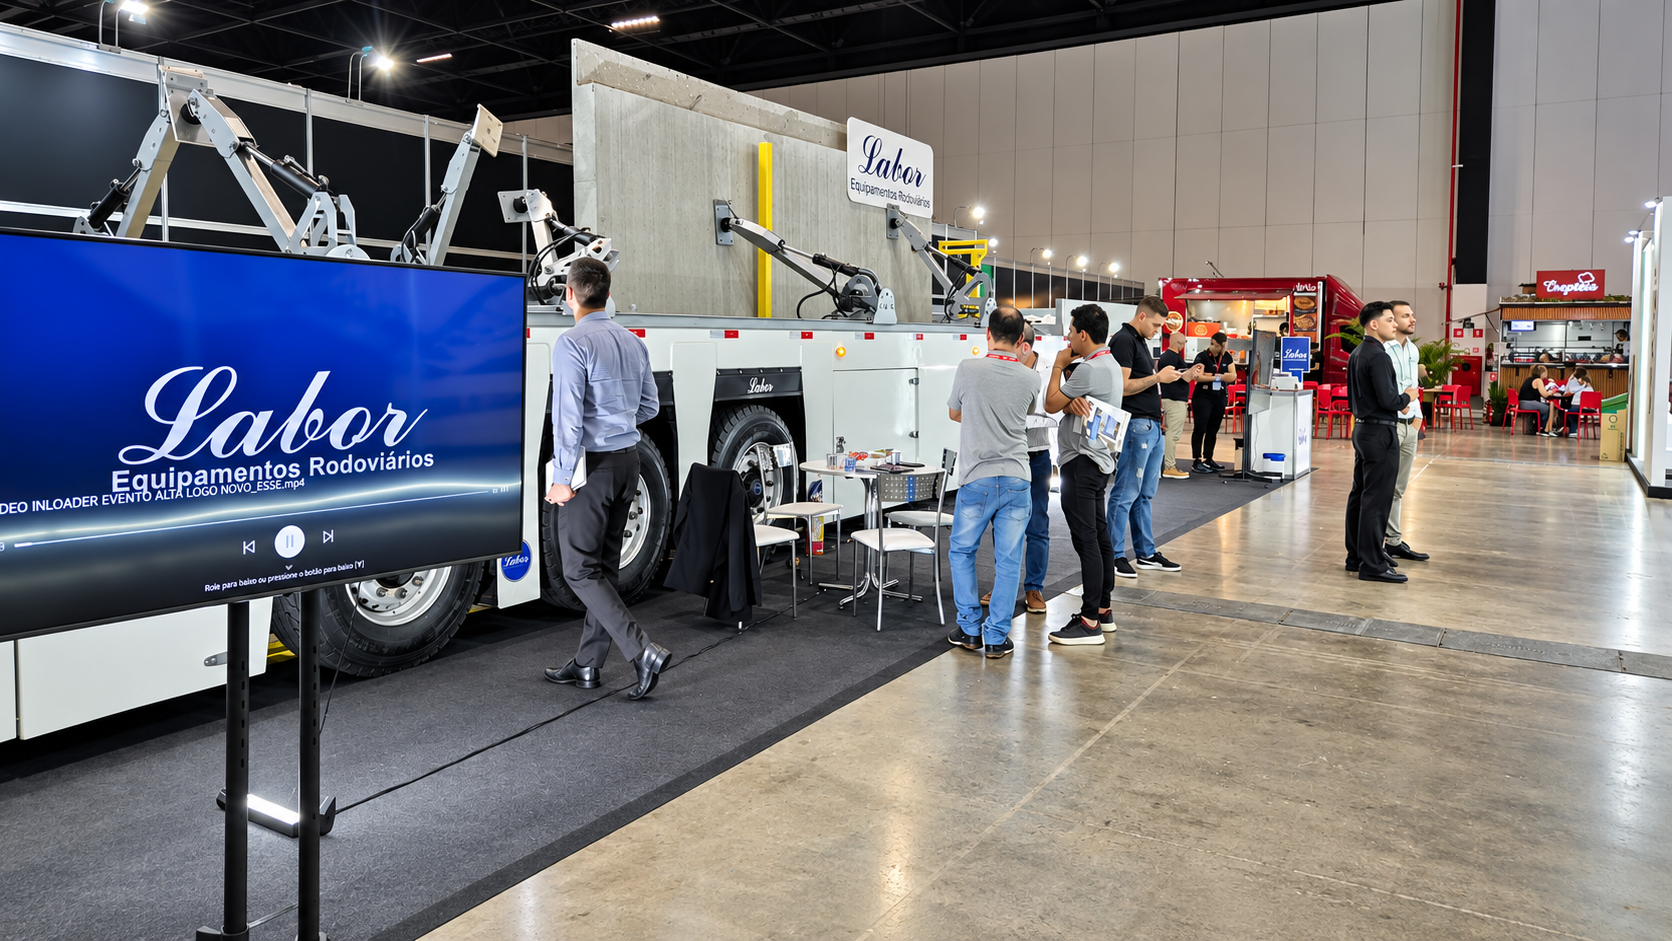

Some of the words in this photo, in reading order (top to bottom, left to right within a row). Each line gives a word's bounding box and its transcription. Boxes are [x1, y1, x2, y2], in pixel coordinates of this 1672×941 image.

[858, 135, 927, 188] Labor
[850, 177, 897, 201] Equipamentos
[747, 376, 774, 395] Labor
[118, 365, 428, 466] Labor
[111, 460, 301, 494] Equipamentos
[309, 450, 434, 477] Rodoviários
[32, 495, 98, 512] INLOADER
[102, 491, 152, 506] EVENTO
[155, 488, 184, 501] ALTA
[186, 485, 218, 498] LOGO
[221, 478, 305, 494] NOVO_ESSE.mp4
[204, 583, 221, 592] Role
[222, 581, 238, 591] para
[239, 577, 257, 587] baixo
[267, 571, 298, 583] pressione
[323, 565, 337, 575] para
[337, 562, 354, 572] baixo
